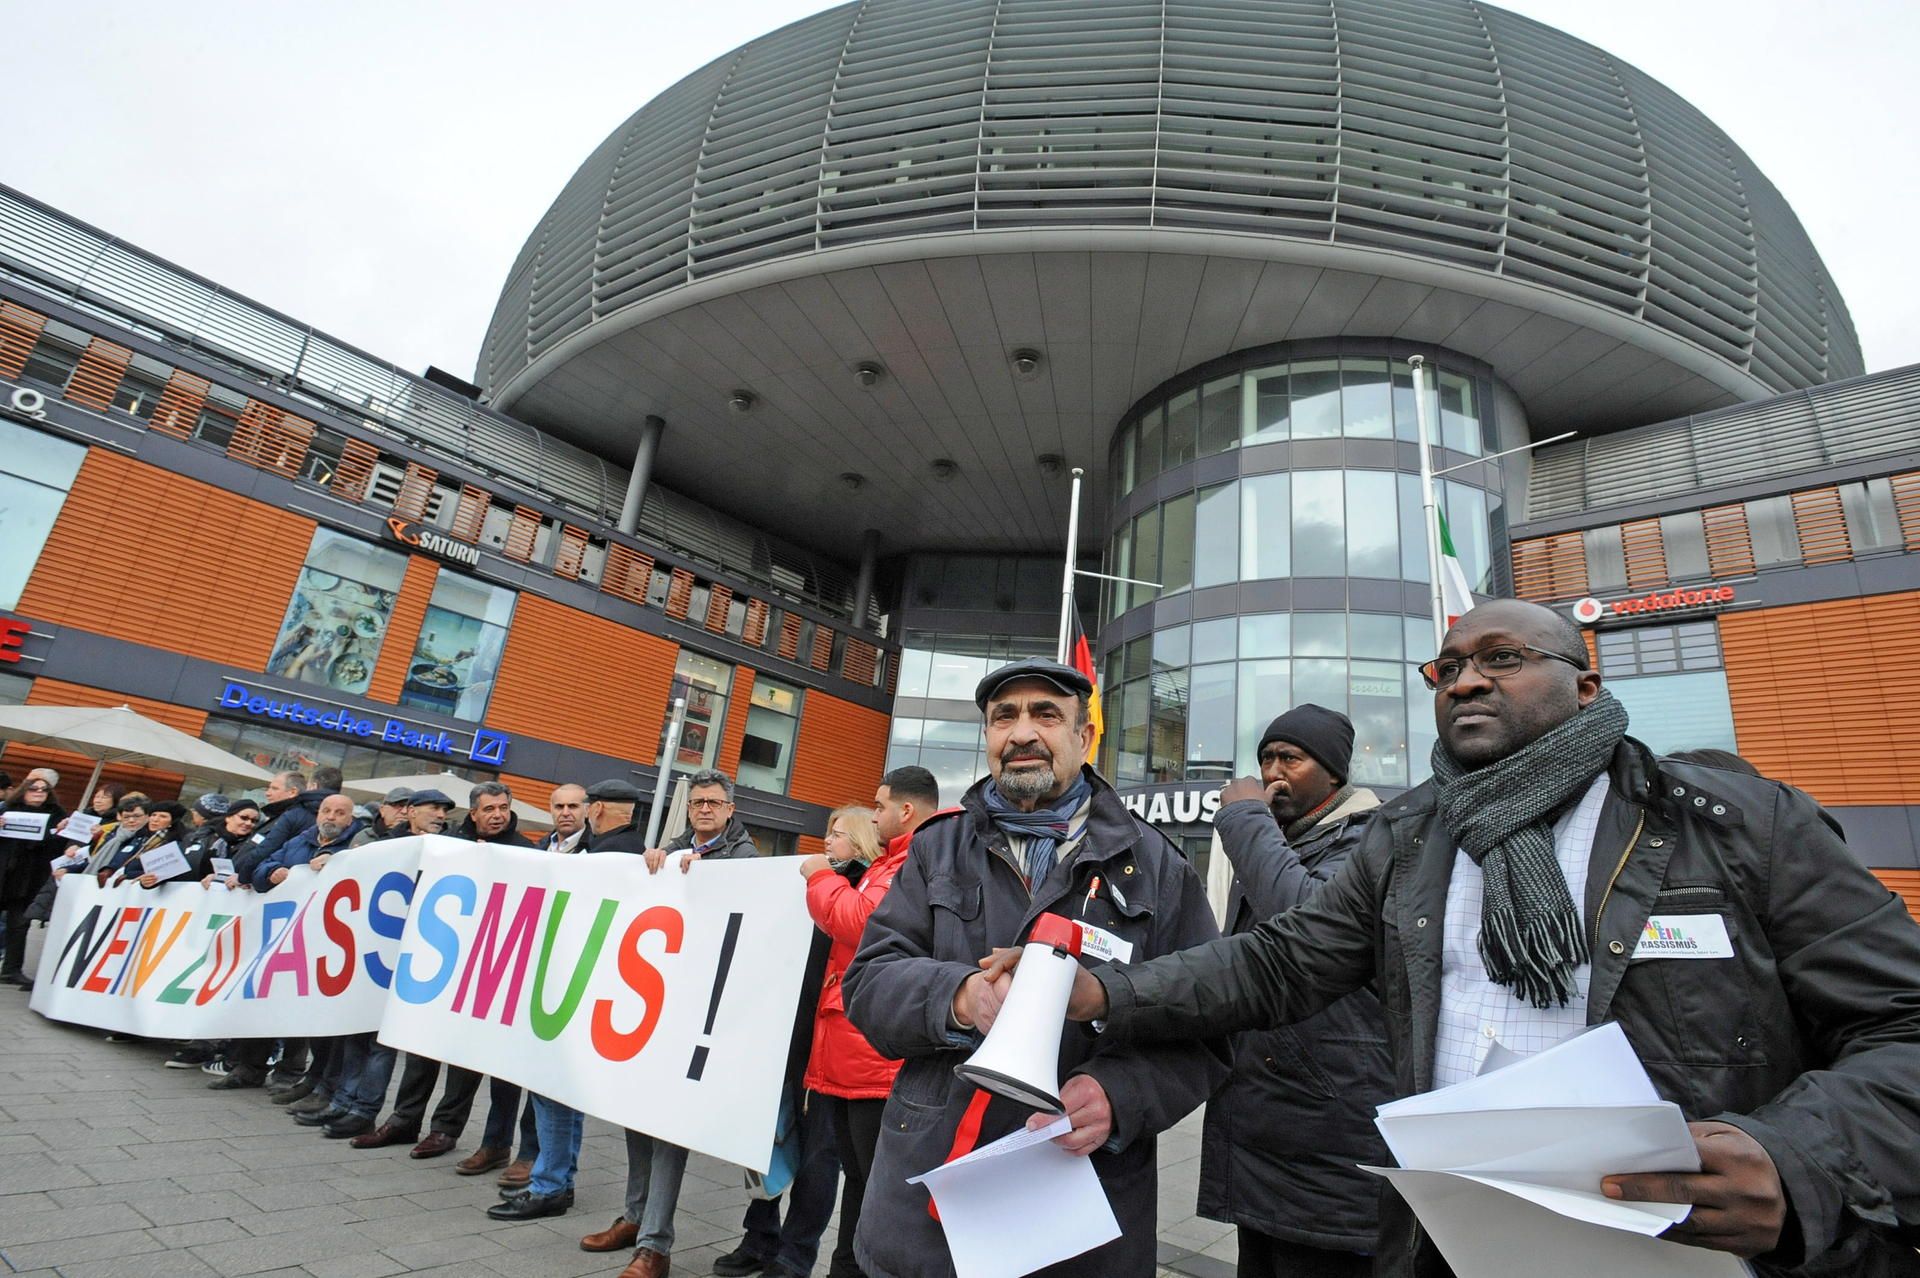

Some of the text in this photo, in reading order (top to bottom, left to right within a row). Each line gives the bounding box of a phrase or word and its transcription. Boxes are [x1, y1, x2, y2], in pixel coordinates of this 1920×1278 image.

[419, 531, 480, 565] SATURN
[1610, 586, 1735, 614] vodafone
[219, 683, 453, 755] Deutsche Bank
[1120, 790, 1222, 824] HAUS
[1082, 940, 1112, 956] ASSISMUS
[1640, 940, 1698, 949] RASSISMUS
[1647, 928, 1682, 940] NEIN
[51, 905, 192, 998] NEIN
[156, 914, 242, 1006] ZU
